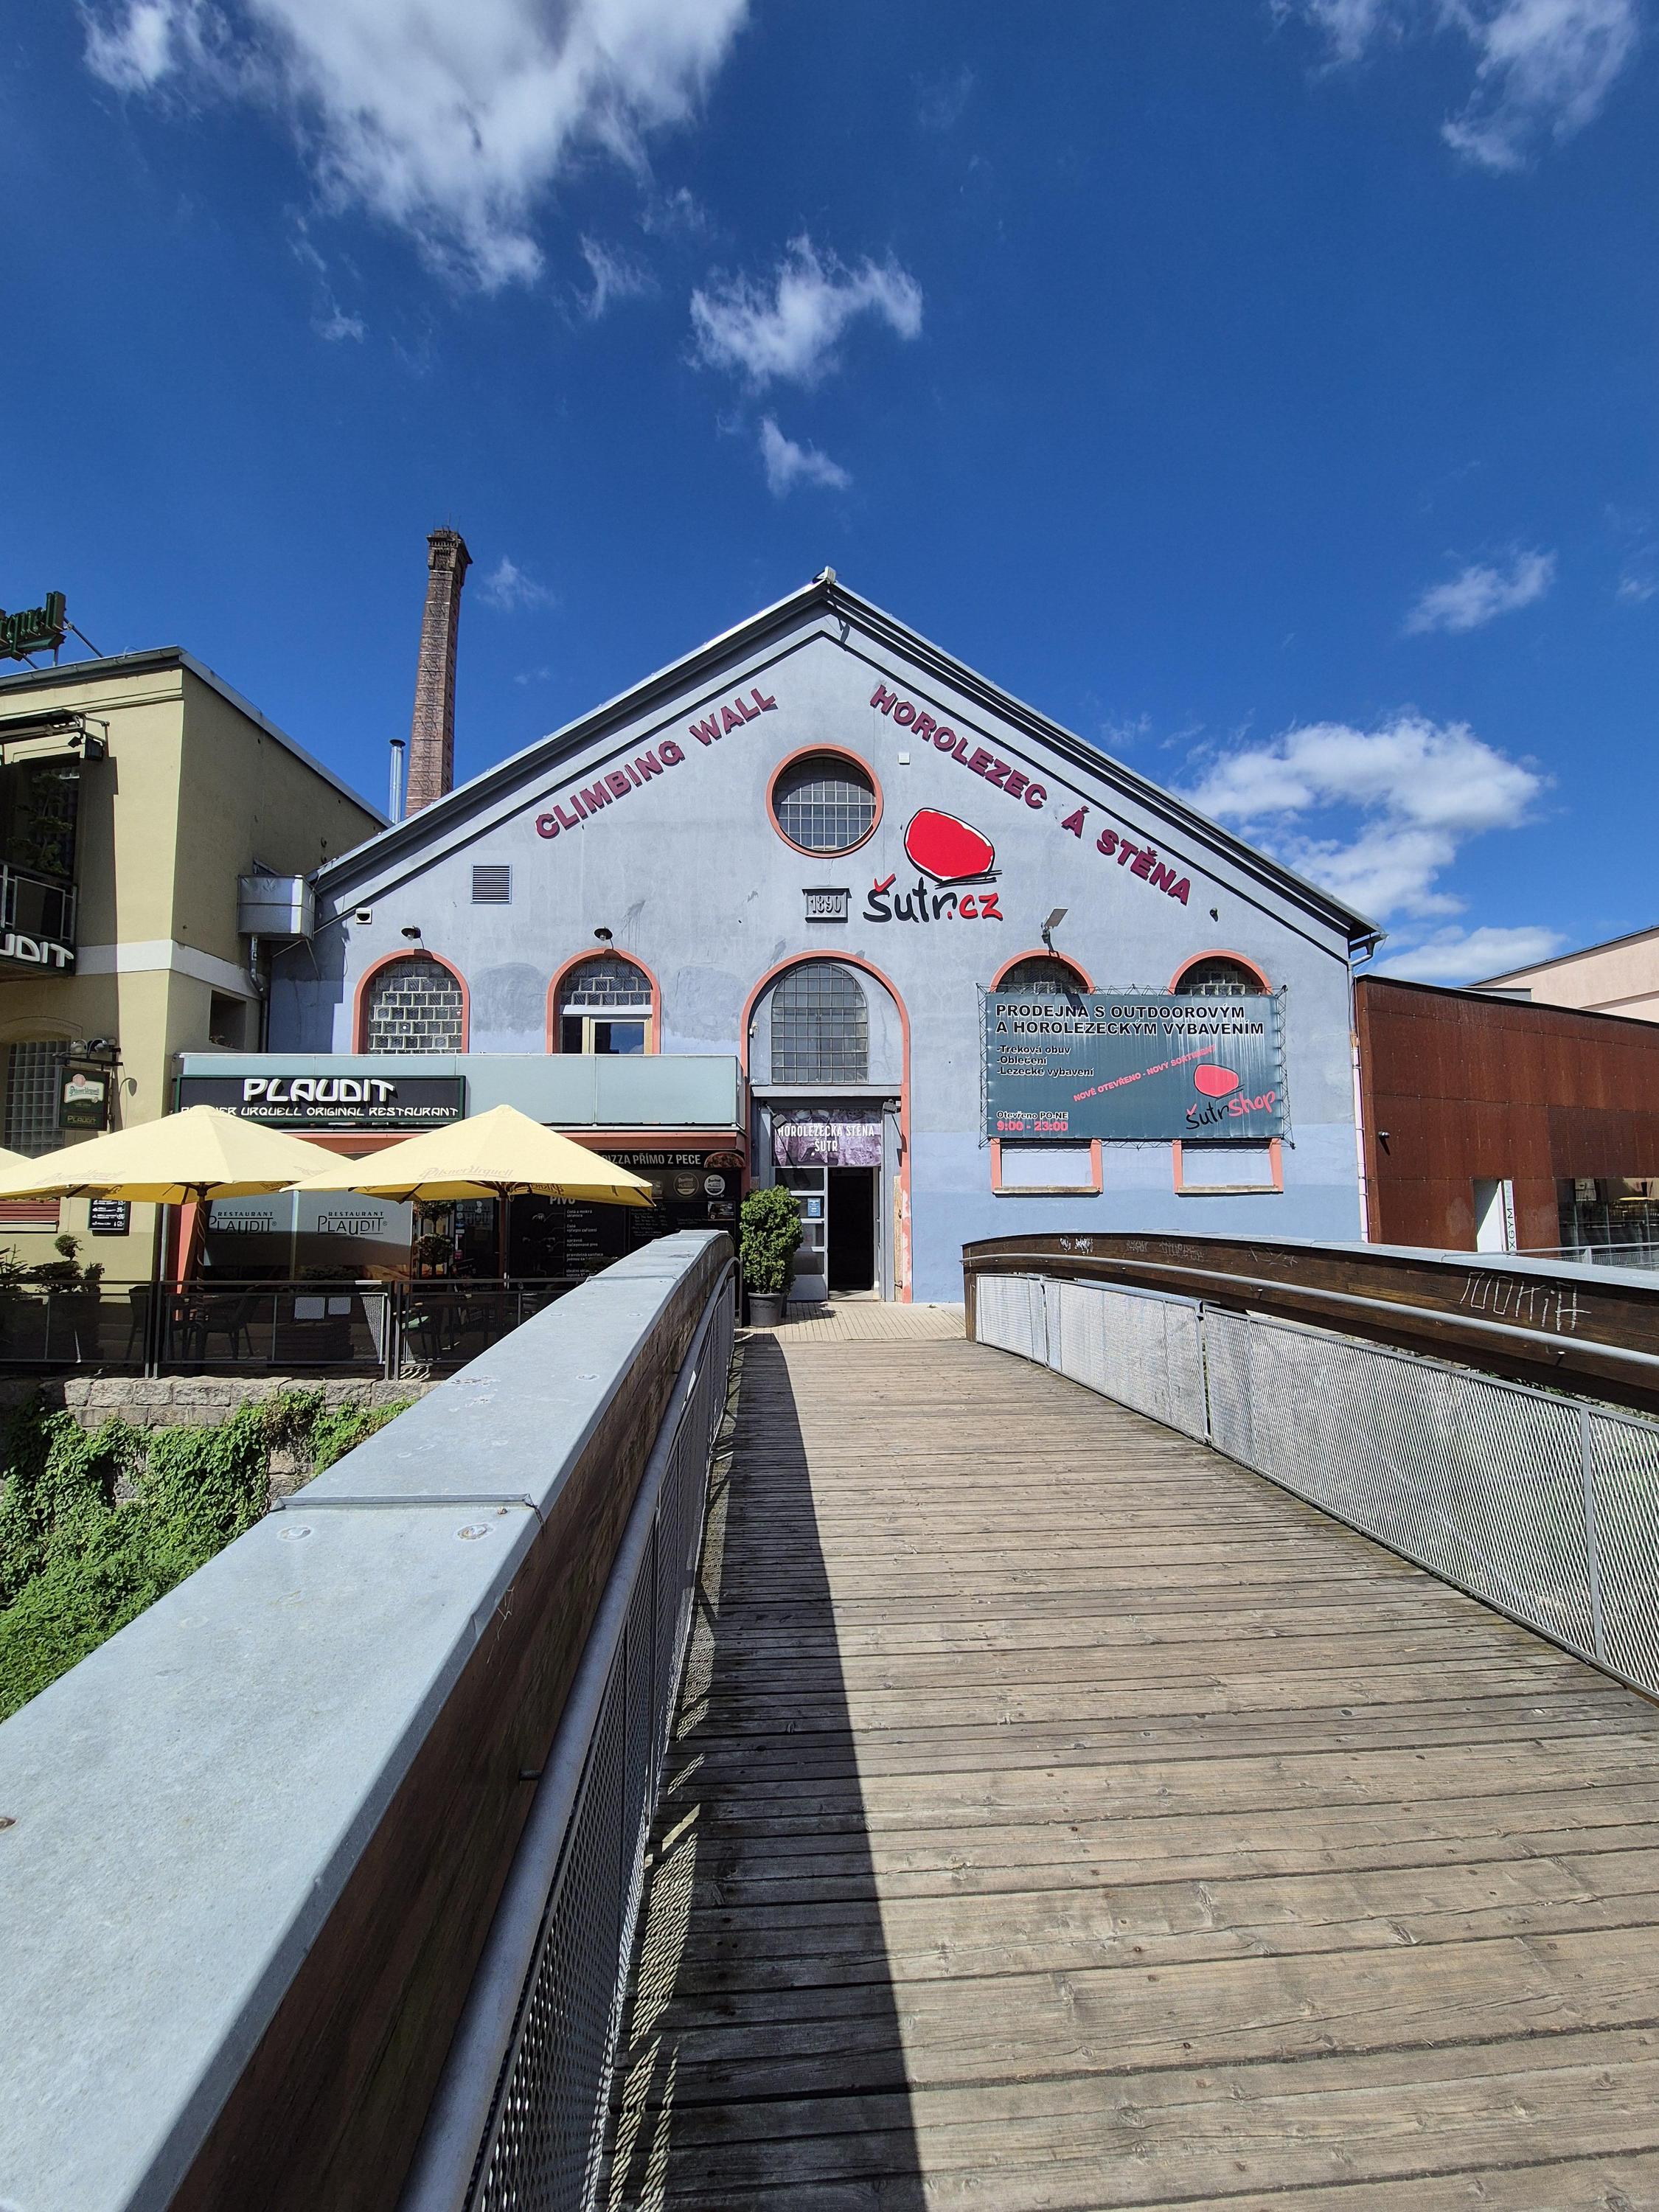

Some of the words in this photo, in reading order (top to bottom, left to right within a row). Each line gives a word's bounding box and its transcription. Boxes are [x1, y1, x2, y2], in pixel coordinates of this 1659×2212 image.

[535, 740, 685, 839] CLIMBING
[689, 688, 776, 746] WALL
[870, 684, 1047, 809] HOROLEZEC
[1096, 829, 1191, 906] STĚNA
[811, 894, 842, 914] 1890
[863, 873, 1003, 923] Šutr.cz
[996, 1004, 1090, 1018] PRODEJNA
[1094, 1005, 1106, 1018] S
[1110, 1004, 1245, 1019] OUTDOOROVÝM
[996, 1021, 1008, 1034] A
[1014, 1020, 1158, 1035] HOROLEZECKÝM
[1162, 1020, 1264, 1035] VYBAVENÍM
[1045, 1045, 1071, 1054] obuv
[1047, 1067, 1094, 1078] vybavení
[1097, 1072, 1142, 1093] OTEVŘENO
[1146, 1061, 1169, 1076] NOVÝ
[1170, 1043, 1216, 1067] SORTIMENT
[243, 1078, 395, 1102] PLAUDIT
[241, 1107, 302, 1116] URQUELL
[306, 1107, 365, 1116] ORIGINAL
[369, 1107, 459, 1116] RESTAURANT
[996, 1110, 1037, 1119] Otevřeno
[1040, 1111, 1068, 1119] PO-NE
[996, 1121, 1023, 1131] 9:00
[1034, 1121, 1068, 1131] 23:00
[633, 1152, 664, 1165] PŘÍMO
[667, 1154, 674, 1164] Z
[676, 1154, 701, 1165] PECE
